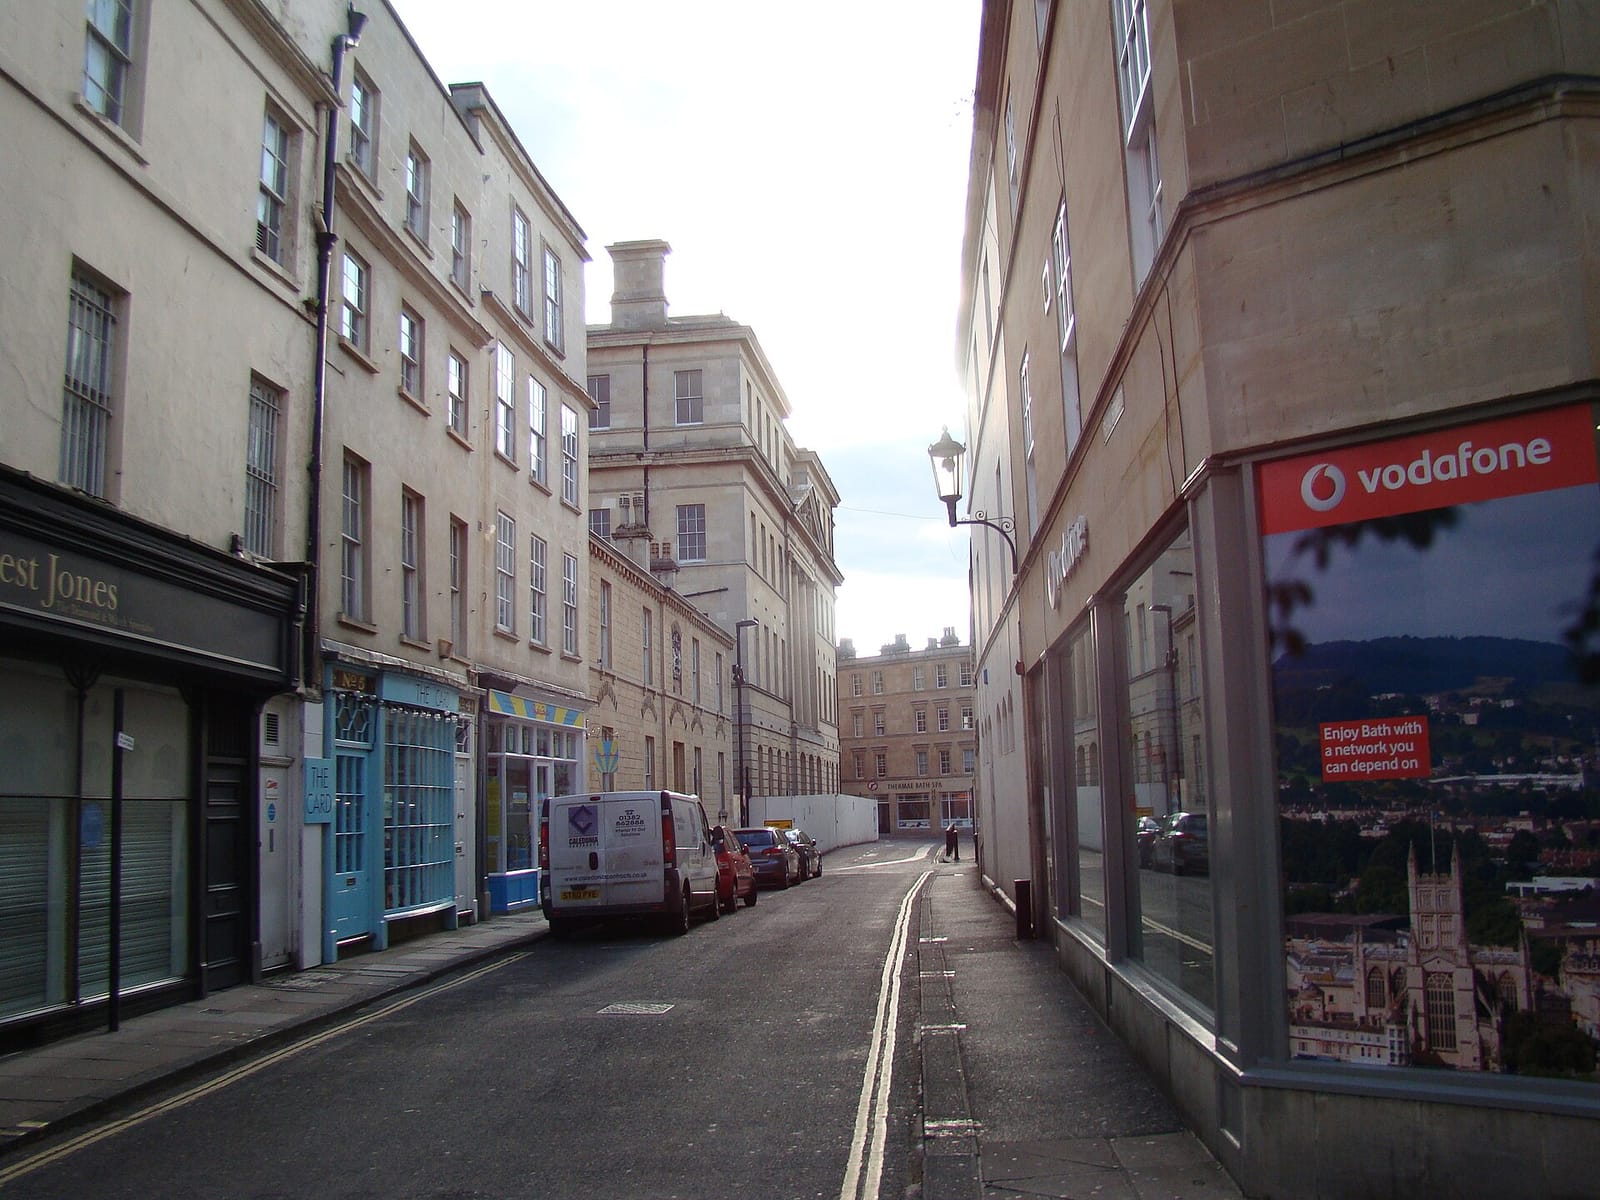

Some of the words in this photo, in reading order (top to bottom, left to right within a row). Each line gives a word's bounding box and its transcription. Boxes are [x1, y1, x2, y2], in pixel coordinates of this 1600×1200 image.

[1358, 438, 1551, 493] vodafone
[41, 553, 118, 610] Jones
[1324, 727, 1359, 741] Enjoy
[1362, 723, 1391, 737] Bath
[1394, 721, 1422, 735] with
[1325, 747, 1332, 756] a
[1335, 741, 1387, 756] network
[1389, 742, 1414, 755] you
[1326, 763, 1348, 773] can
[1351, 757, 1398, 774] depend
[1401, 759, 1418, 769] on
[312, 766, 329, 789] THE
[308, 793, 332, 814] CARD
